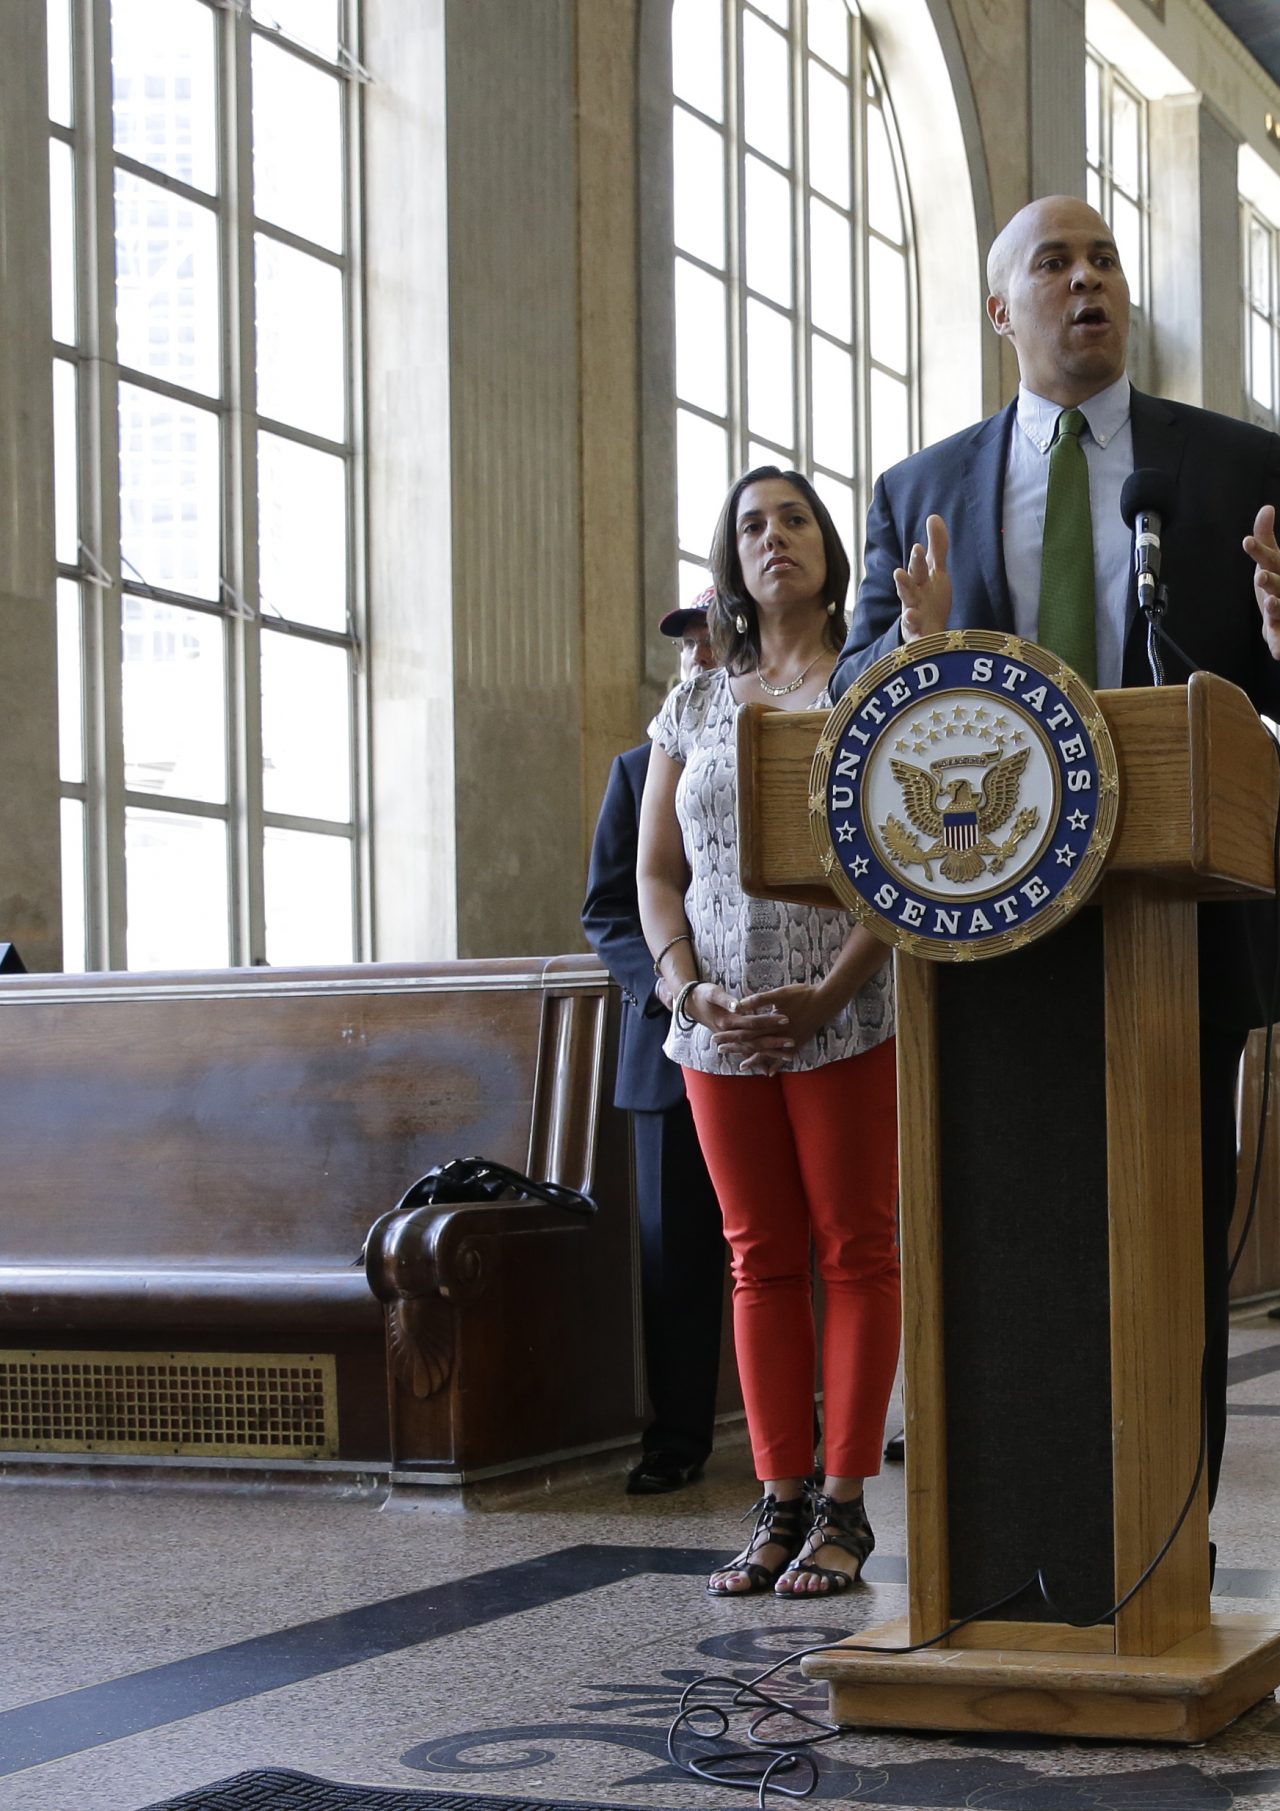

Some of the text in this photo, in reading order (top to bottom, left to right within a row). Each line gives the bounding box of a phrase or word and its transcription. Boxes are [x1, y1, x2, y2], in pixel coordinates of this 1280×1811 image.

[832, 658, 1091, 811] UNITED STATES
[874, 876, 1051, 934] SENATE
